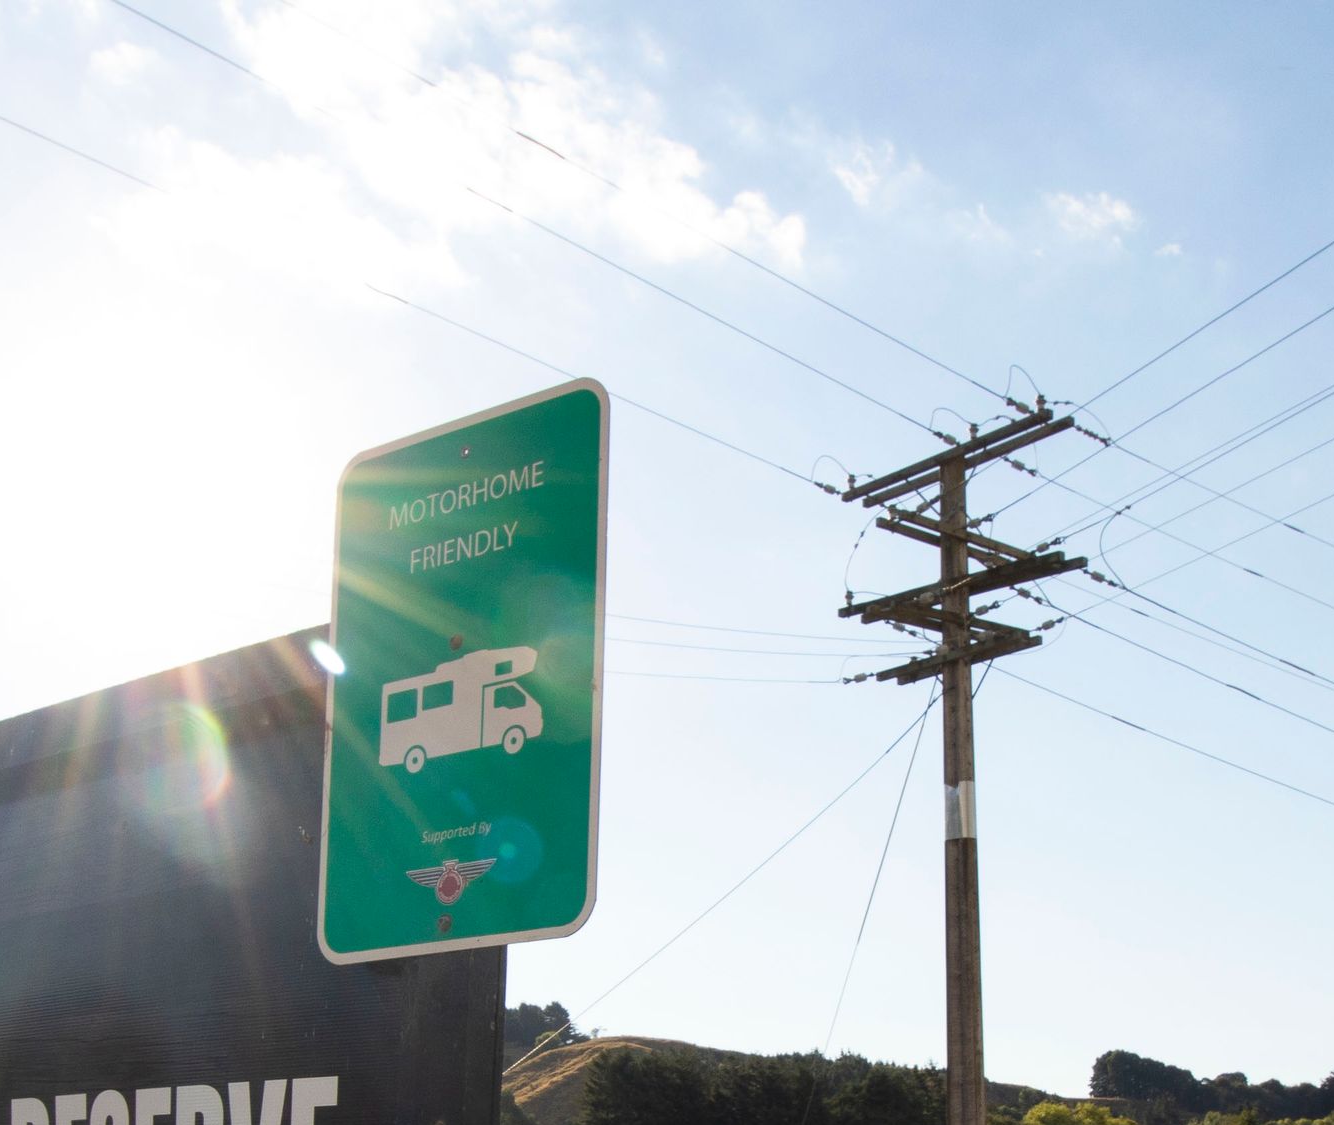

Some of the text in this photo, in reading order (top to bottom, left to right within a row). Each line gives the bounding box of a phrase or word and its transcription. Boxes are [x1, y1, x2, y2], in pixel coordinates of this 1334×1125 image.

[388, 460, 544, 530] MOTORHOME
[410, 520, 518, 574] FRIENDLY
[421, 820, 492, 845] Supported By
